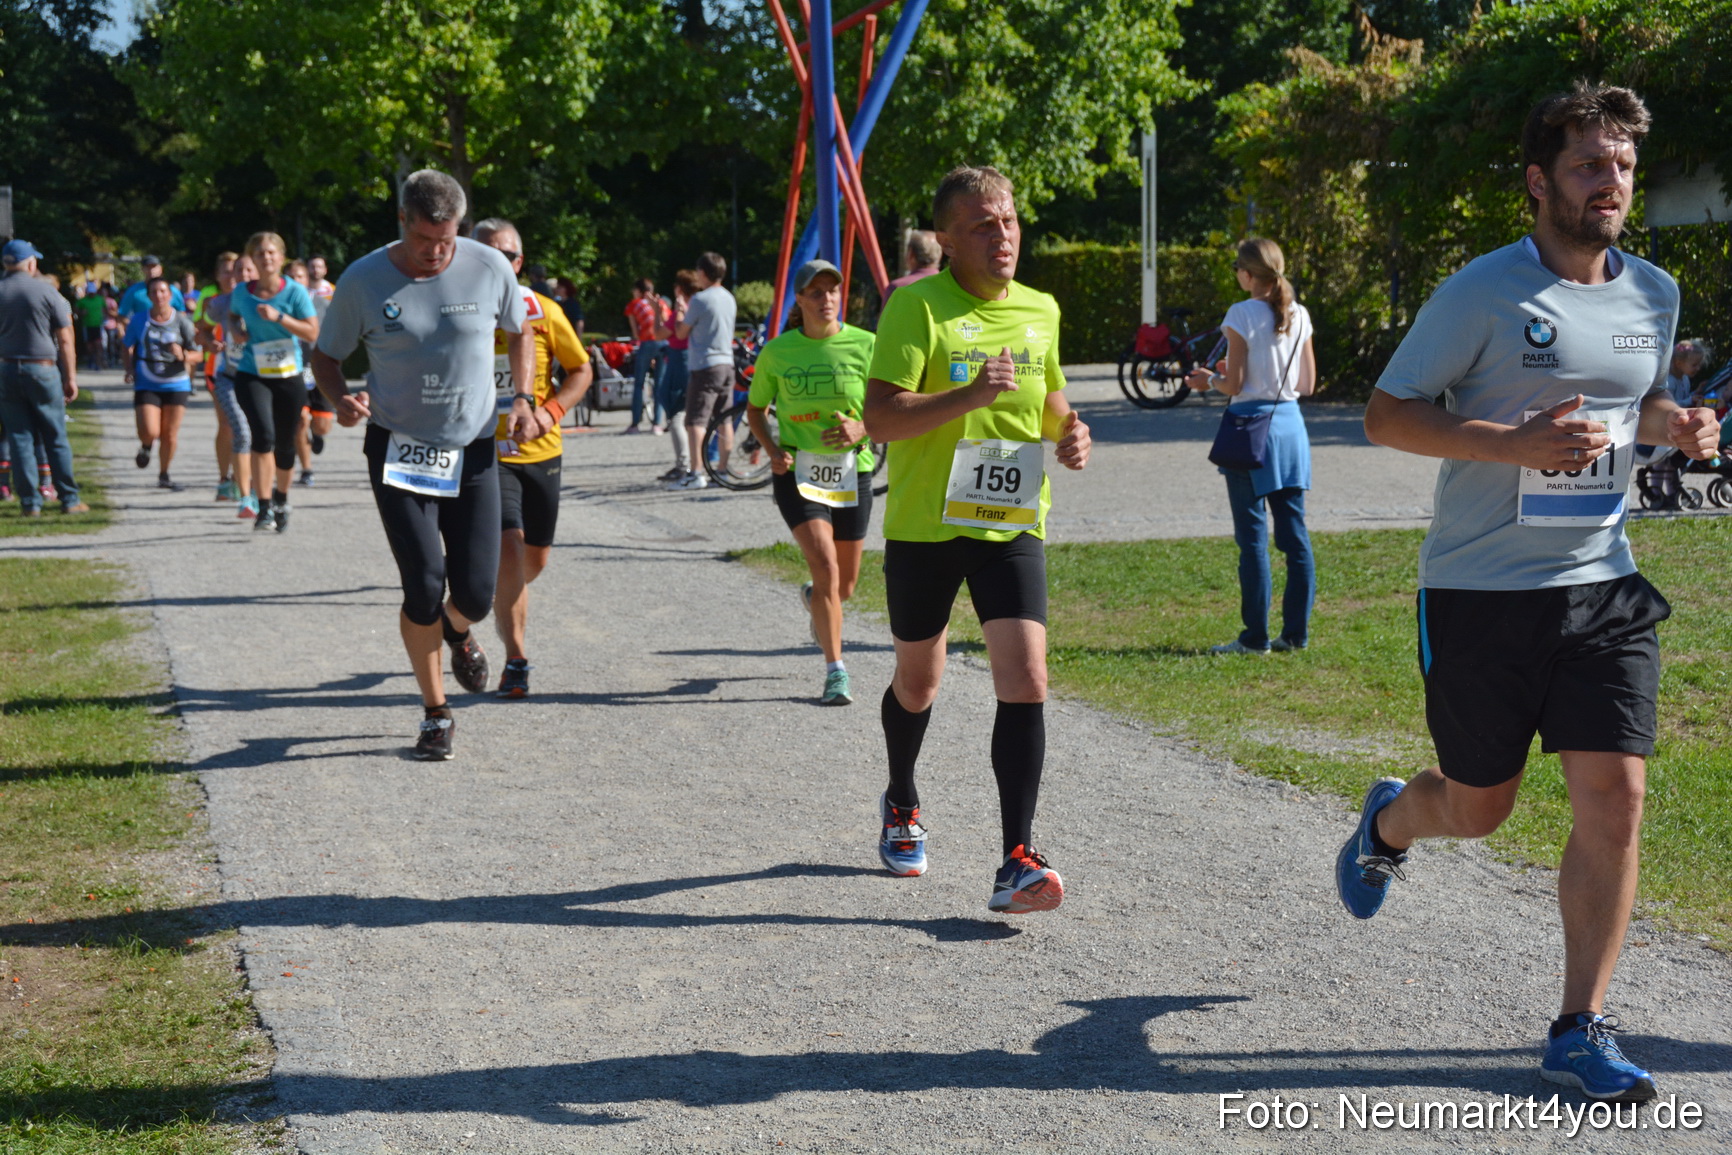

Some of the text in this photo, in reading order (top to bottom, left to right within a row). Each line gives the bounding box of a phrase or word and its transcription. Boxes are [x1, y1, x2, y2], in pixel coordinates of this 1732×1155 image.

[1612, 335, 1657, 349] BOCK
[1523, 354, 1559, 362] PARTL
[422, 374, 443, 387] 19.
[399, 444, 450, 469] 2595
[980, 447, 1018, 460] BOCK
[810, 465, 842, 483] 305
[973, 464, 1021, 493] 159
[966, 493, 1013, 504] PARTL Neumarkt
[975, 506, 1006, 520] Franz
